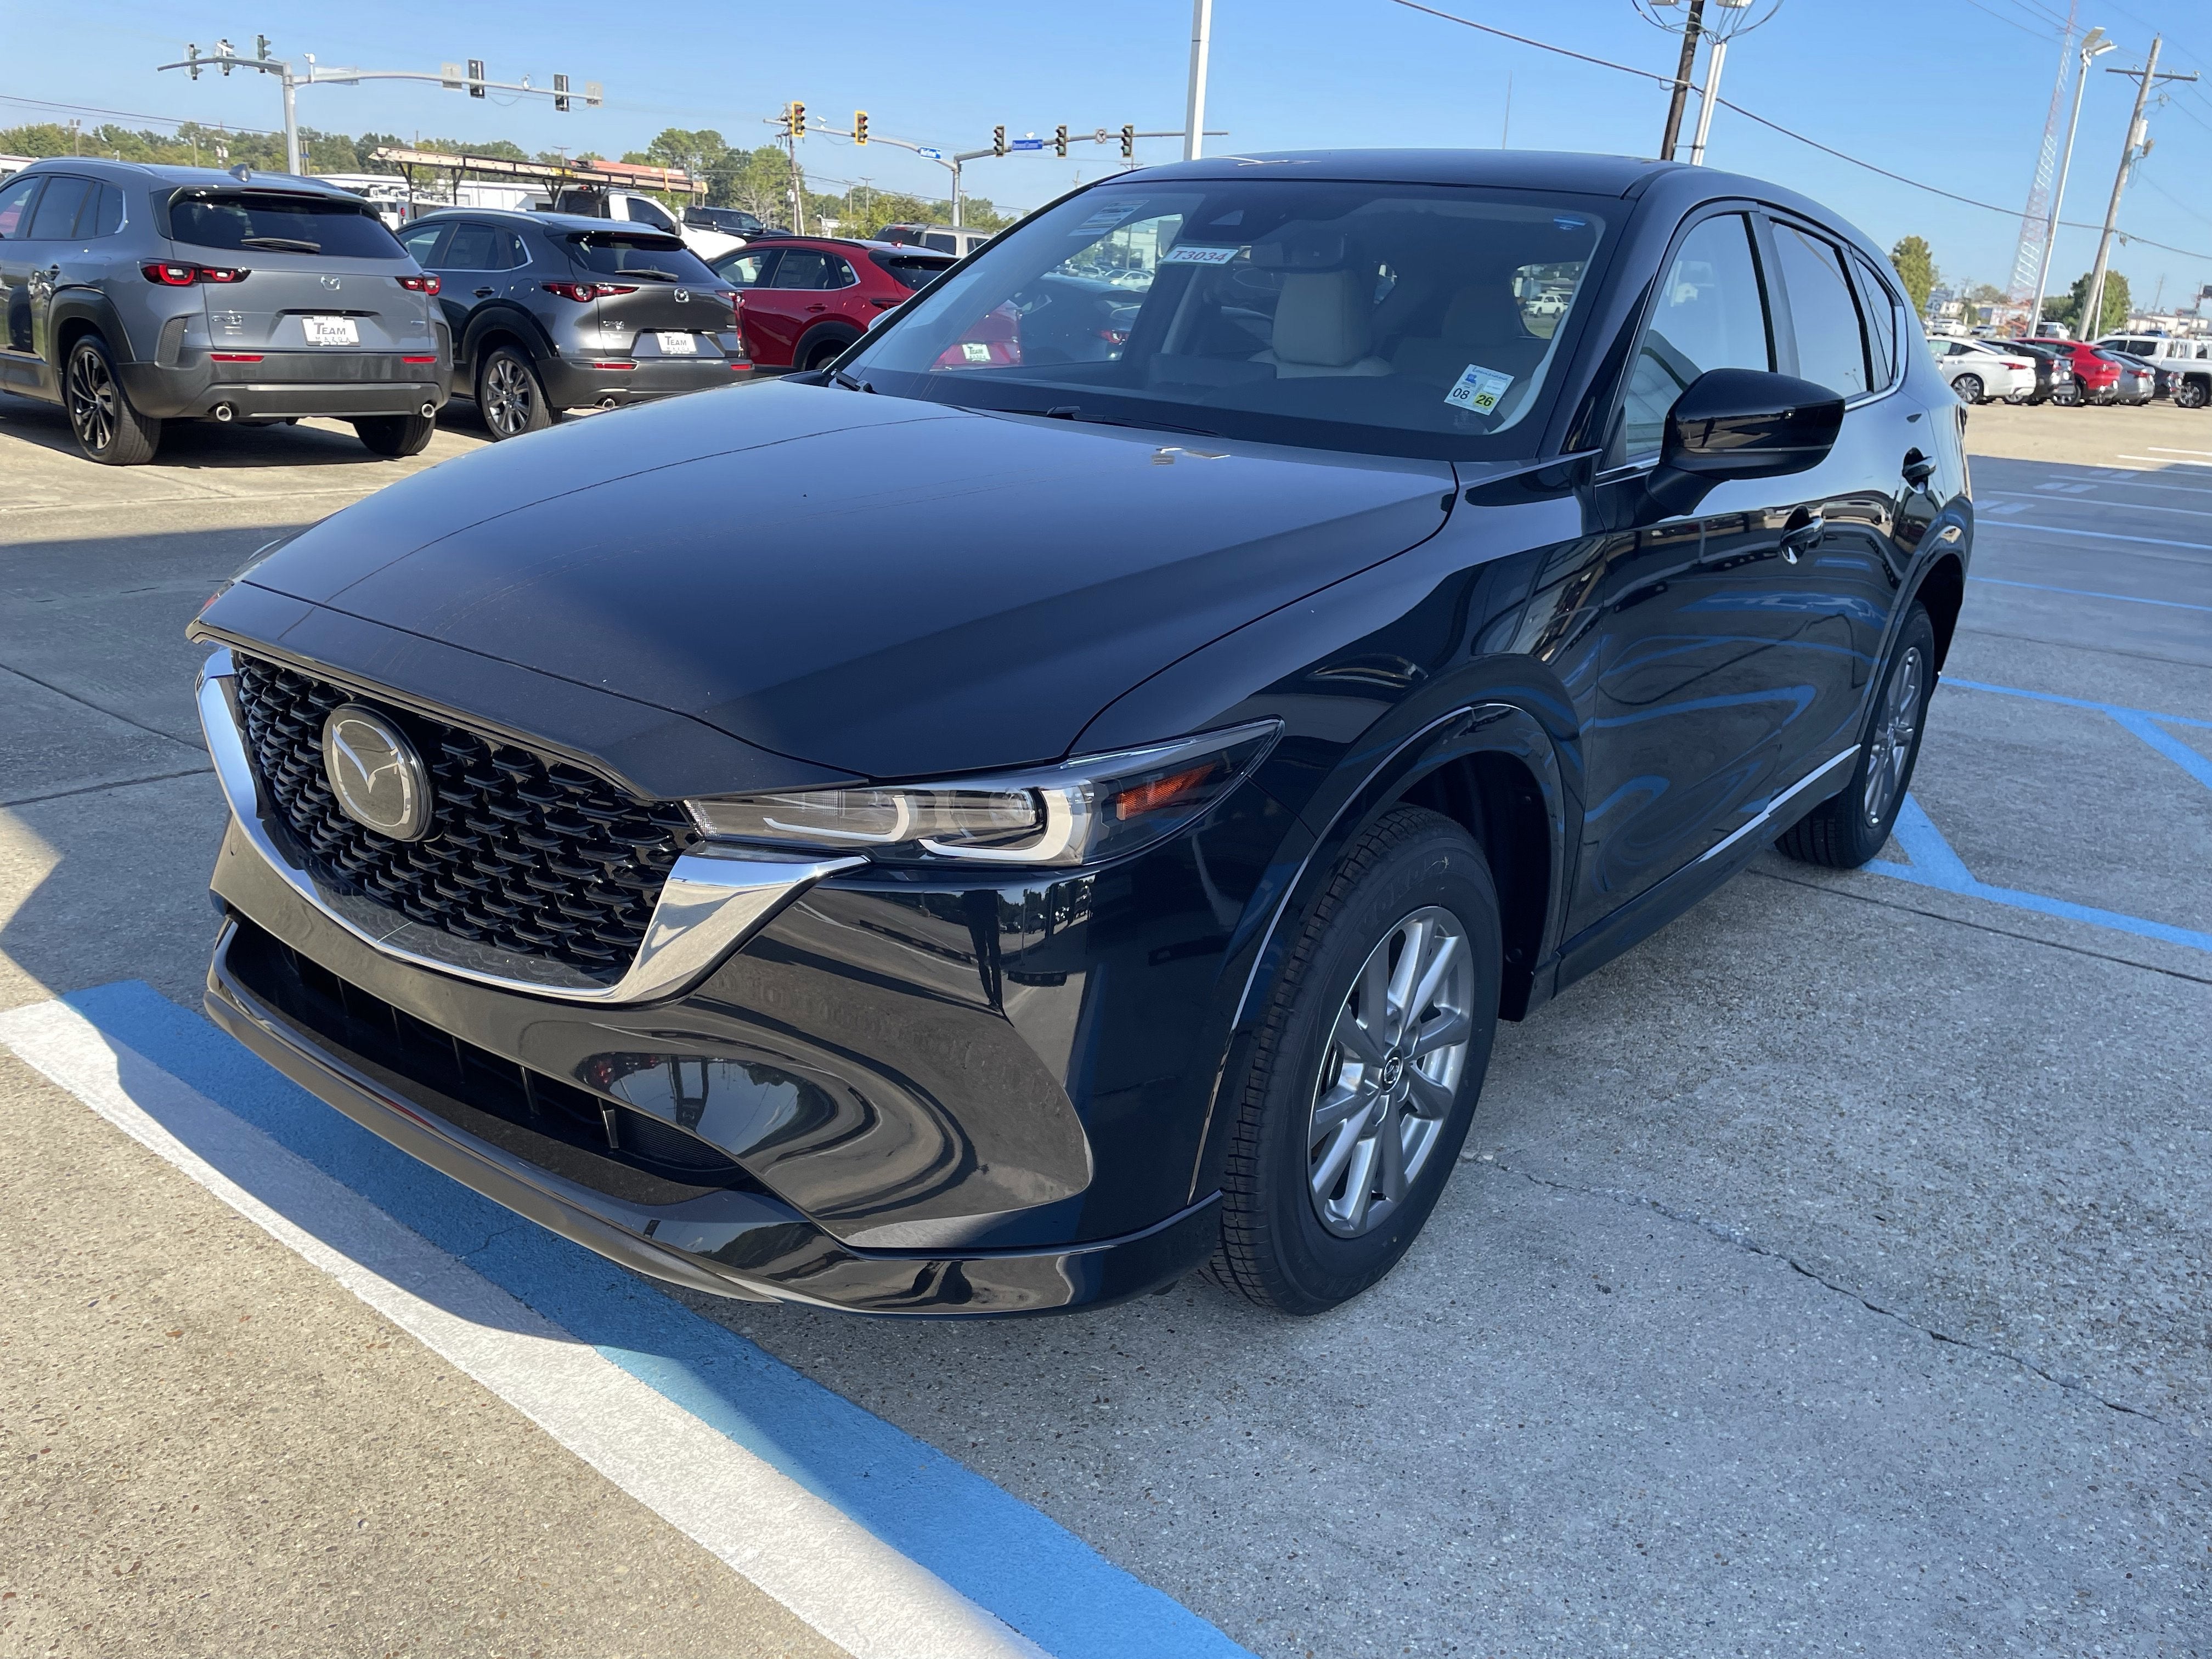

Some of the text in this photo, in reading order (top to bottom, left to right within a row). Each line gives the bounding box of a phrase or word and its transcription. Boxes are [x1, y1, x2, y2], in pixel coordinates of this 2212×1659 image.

[1172, 250, 1228, 262] T3034
[1453, 388, 1470, 399] 08
[1475, 394, 1494, 407] 26
